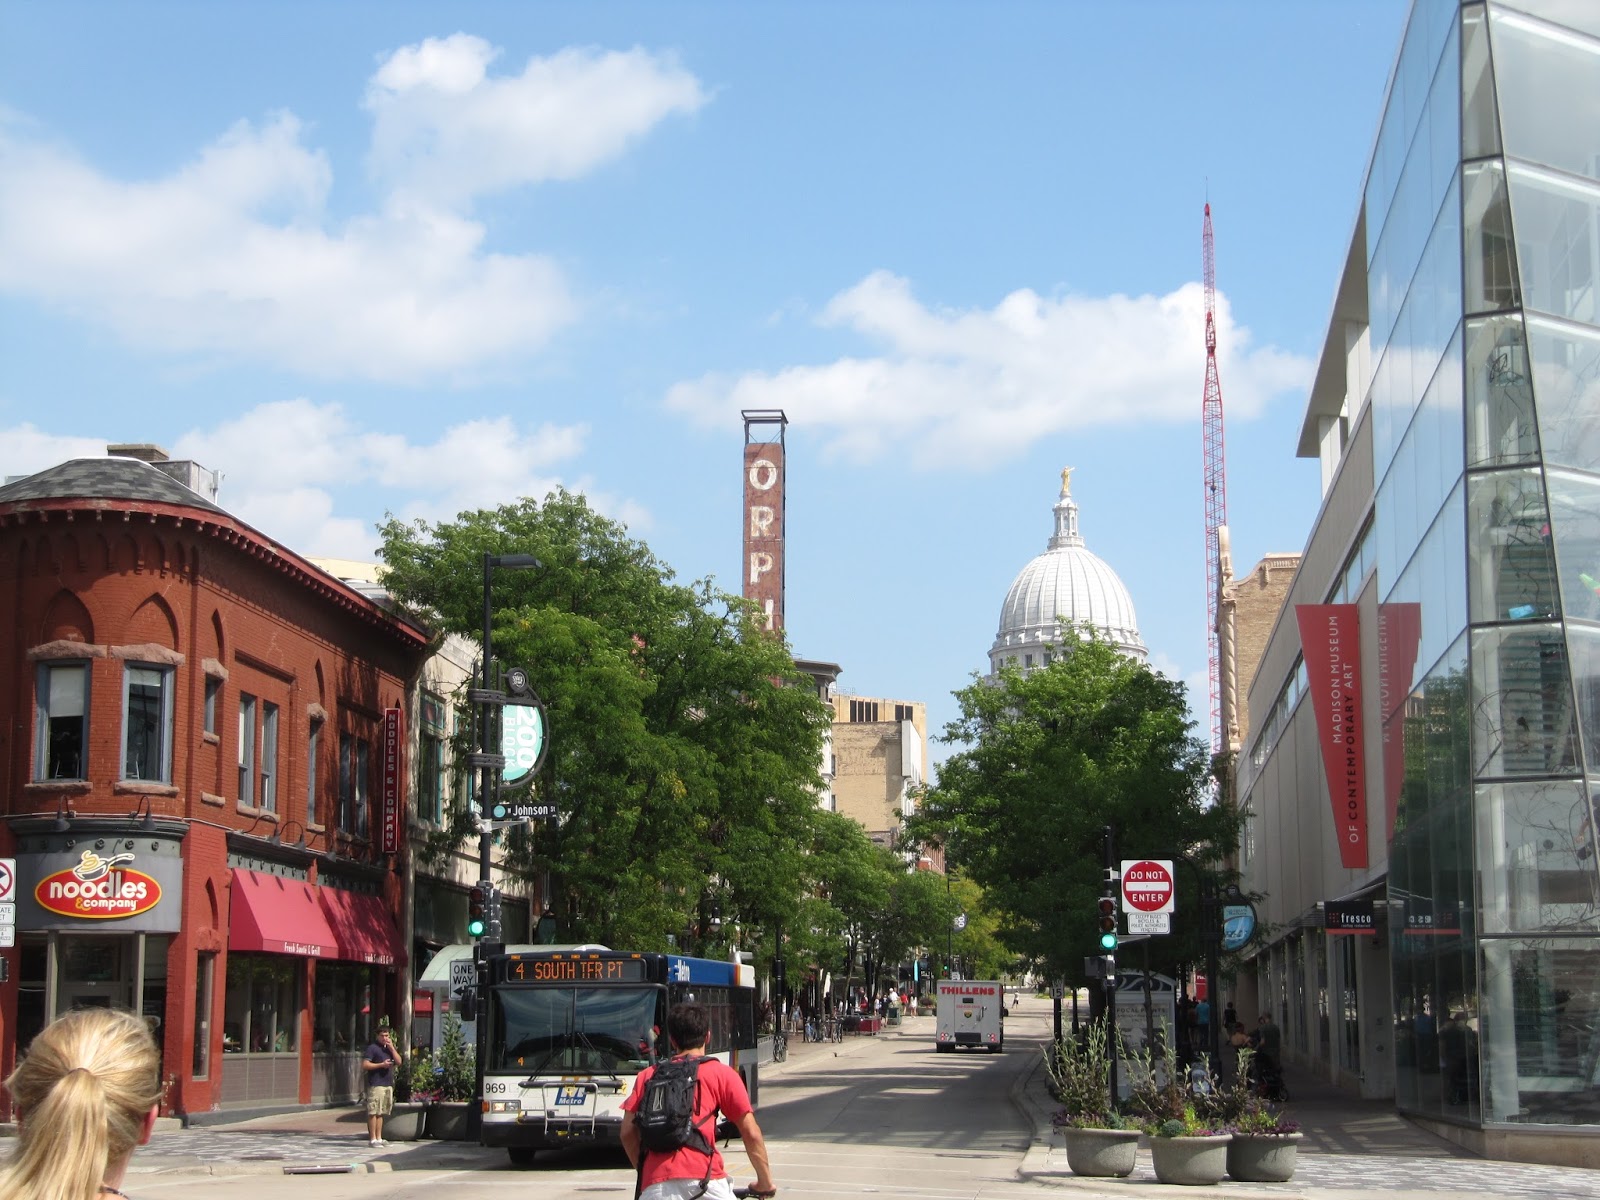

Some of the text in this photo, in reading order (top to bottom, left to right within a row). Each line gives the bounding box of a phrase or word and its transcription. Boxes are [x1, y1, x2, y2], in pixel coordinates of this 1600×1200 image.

[1329, 615, 1342, 743] MADISON MUSEUM
[504, 717, 516, 767] BLOCK
[516, 705, 537, 769] 200
[1343, 663, 1359, 843] OF CONTEMPORARY ART
[386, 714, 396, 848] NOODLES & COMPANY
[512, 804, 549, 816] Johnson
[1130, 870, 1164, 880] DO NOT
[49, 870, 148, 899] noodles
[1132, 893, 1164, 902] ENTER
[1341, 912, 1371, 923] fresco
[284, 941, 296, 953] Fresh
[453, 964, 473, 974] ONE
[515, 961, 624, 980] 4 SOUTH TFR PT
[453, 975, 474, 985] WAY
[940, 986, 995, 996] THILLENS
[517, 1056, 524, 1067] 4
[485, 1083, 506, 1094] 969
